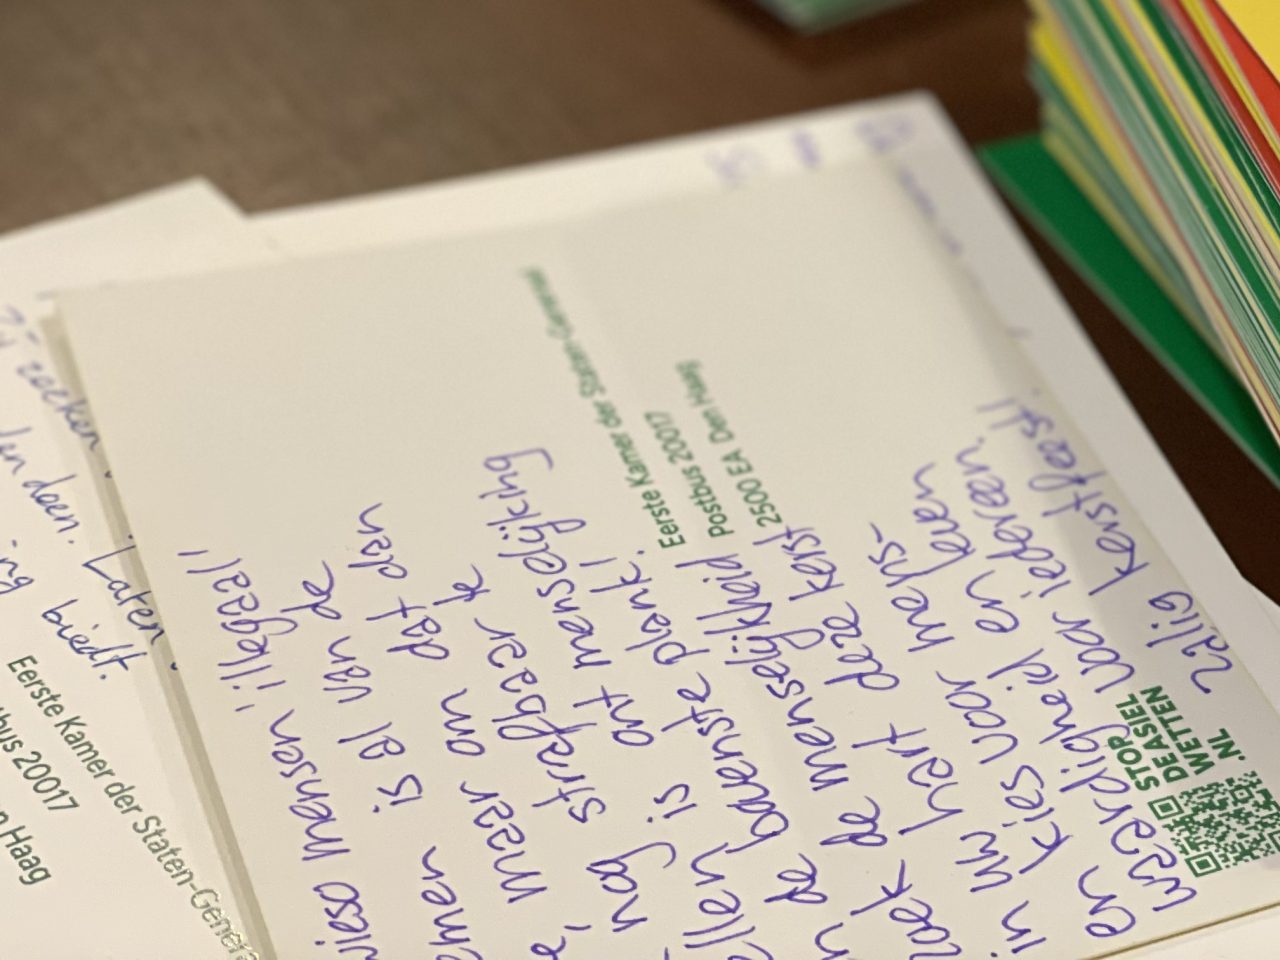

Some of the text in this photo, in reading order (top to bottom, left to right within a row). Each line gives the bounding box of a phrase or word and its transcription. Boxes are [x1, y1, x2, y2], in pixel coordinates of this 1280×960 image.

[593, 401, 623, 429] der
[610, 432, 654, 488] Kamer
[643, 411, 735, 538] Postbus 20017
[720, 448, 754, 477] EA
[641, 489, 687, 549] Eerste
[736, 478, 783, 528] 2500
[346, 503, 408, 579] dan
[279, 560, 342, 620] de
[42, 599, 147, 680] biedt.
[367, 597, 450, 661] dat
[1051, 611, 1135, 694] voor
[323, 636, 373, 704] van
[674, 553, 849, 792] menselijkheid
[912, 463, 1198, 912] waardigheid en leven
[6, 655, 65, 717] Eerste
[54, 715, 115, 779] Kamer
[104, 782, 143, 814] der
[336, 723, 406, 760] al
[432, 565, 677, 933] nog strafbaar te
[440, 688, 486, 757] om
[572, 688, 656, 747] ont
[752, 527, 1047, 958] in uw hart deze kerst
[935, 672, 1019, 765] voor
[1115, 693, 1170, 750] ASIEL
[1139, 685, 1215, 776] WETTEN
[1207, 728, 1246, 761] .NL
[11, 751, 80, 811] 20017
[269, 709, 351, 862] mensen
[372, 774, 423, 814] is
[660, 673, 790, 855] bovenste
[1106, 736, 1160, 791] STOP
[646, 783, 698, 824] is
[819, 796, 888, 847] de
[1000, 765, 1072, 875] kies
[0, 825, 52, 885] Haag
[459, 781, 548, 904] maar
[763, 853, 828, 904] de
[1078, 865, 1137, 938] en
